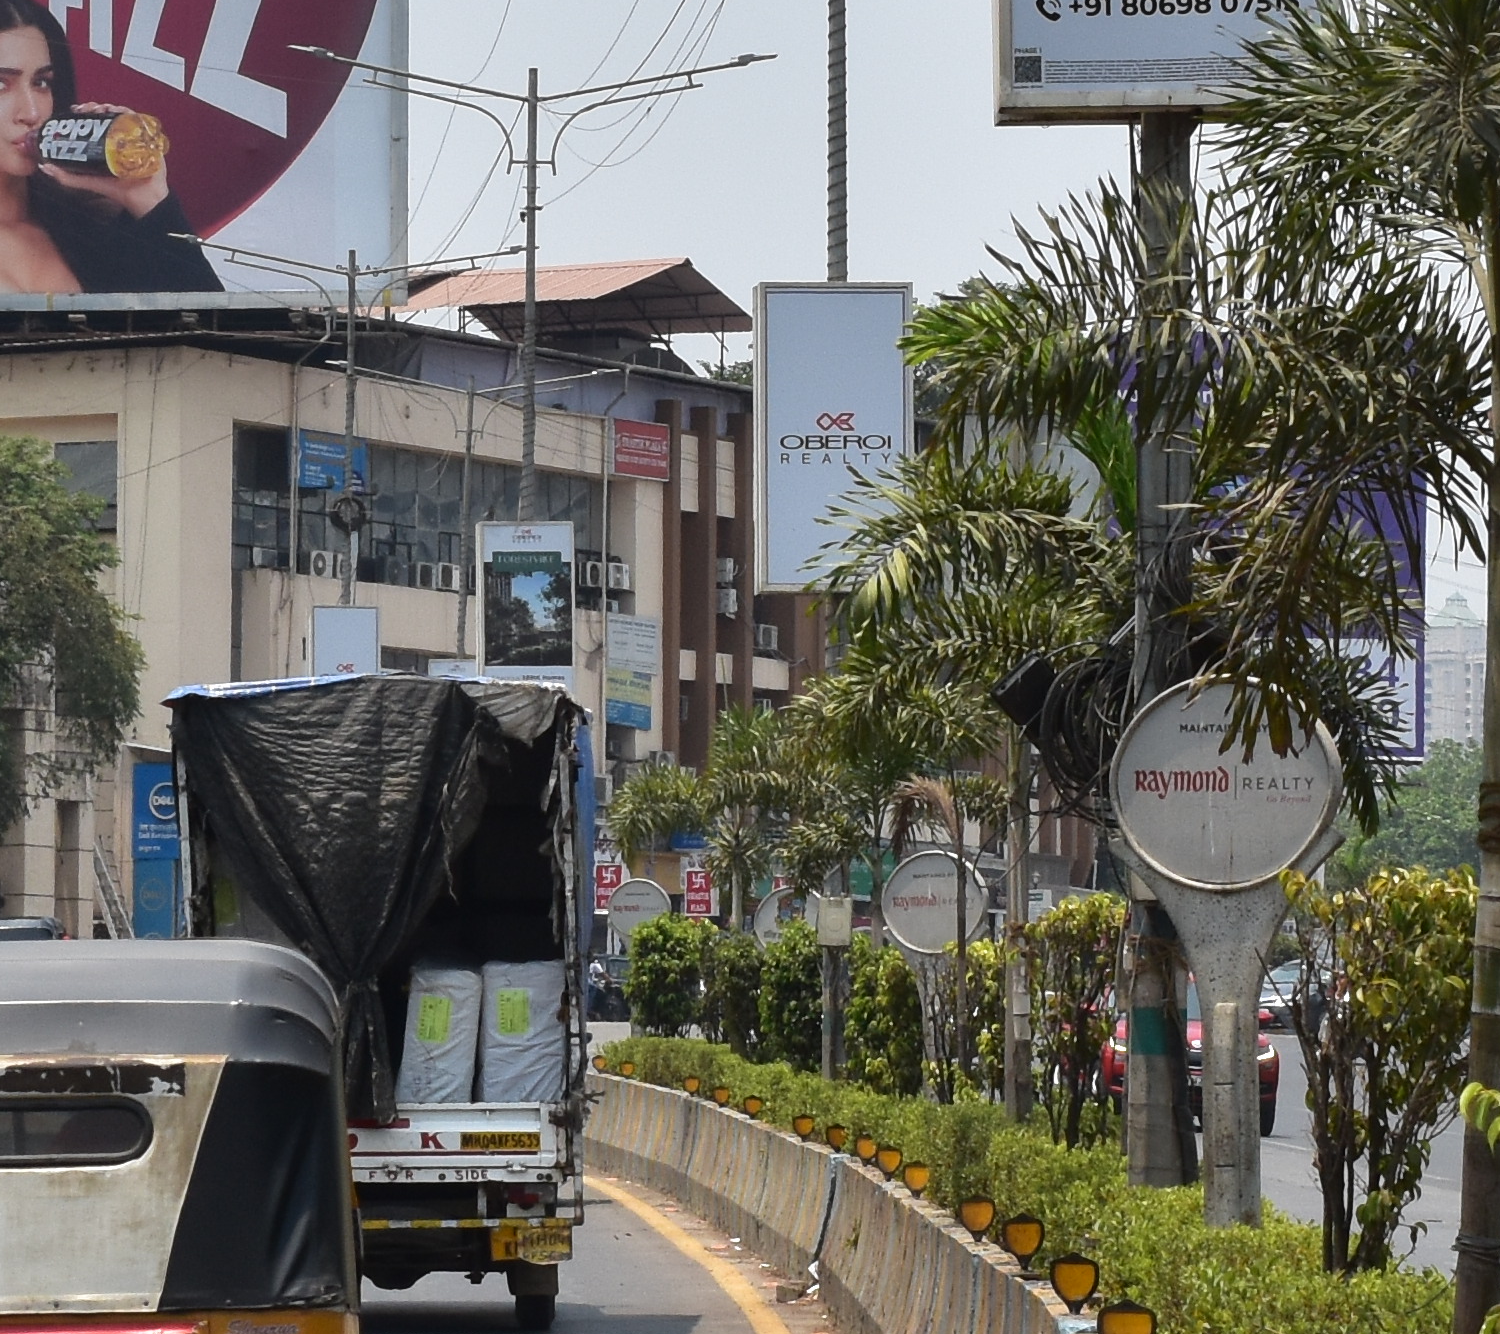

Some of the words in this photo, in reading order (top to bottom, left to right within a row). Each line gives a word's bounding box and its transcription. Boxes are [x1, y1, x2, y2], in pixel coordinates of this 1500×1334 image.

[42, 119, 112, 142] appy
[39, 137, 88, 161] fizz
[780, 435, 891, 449] OBEROI
[780, 453, 891, 464] REALTY
[1135, 766, 1229, 799] Raymond
[1242, 777, 1314, 790] REALTY
[455, 1170, 489, 1180] SIDE
